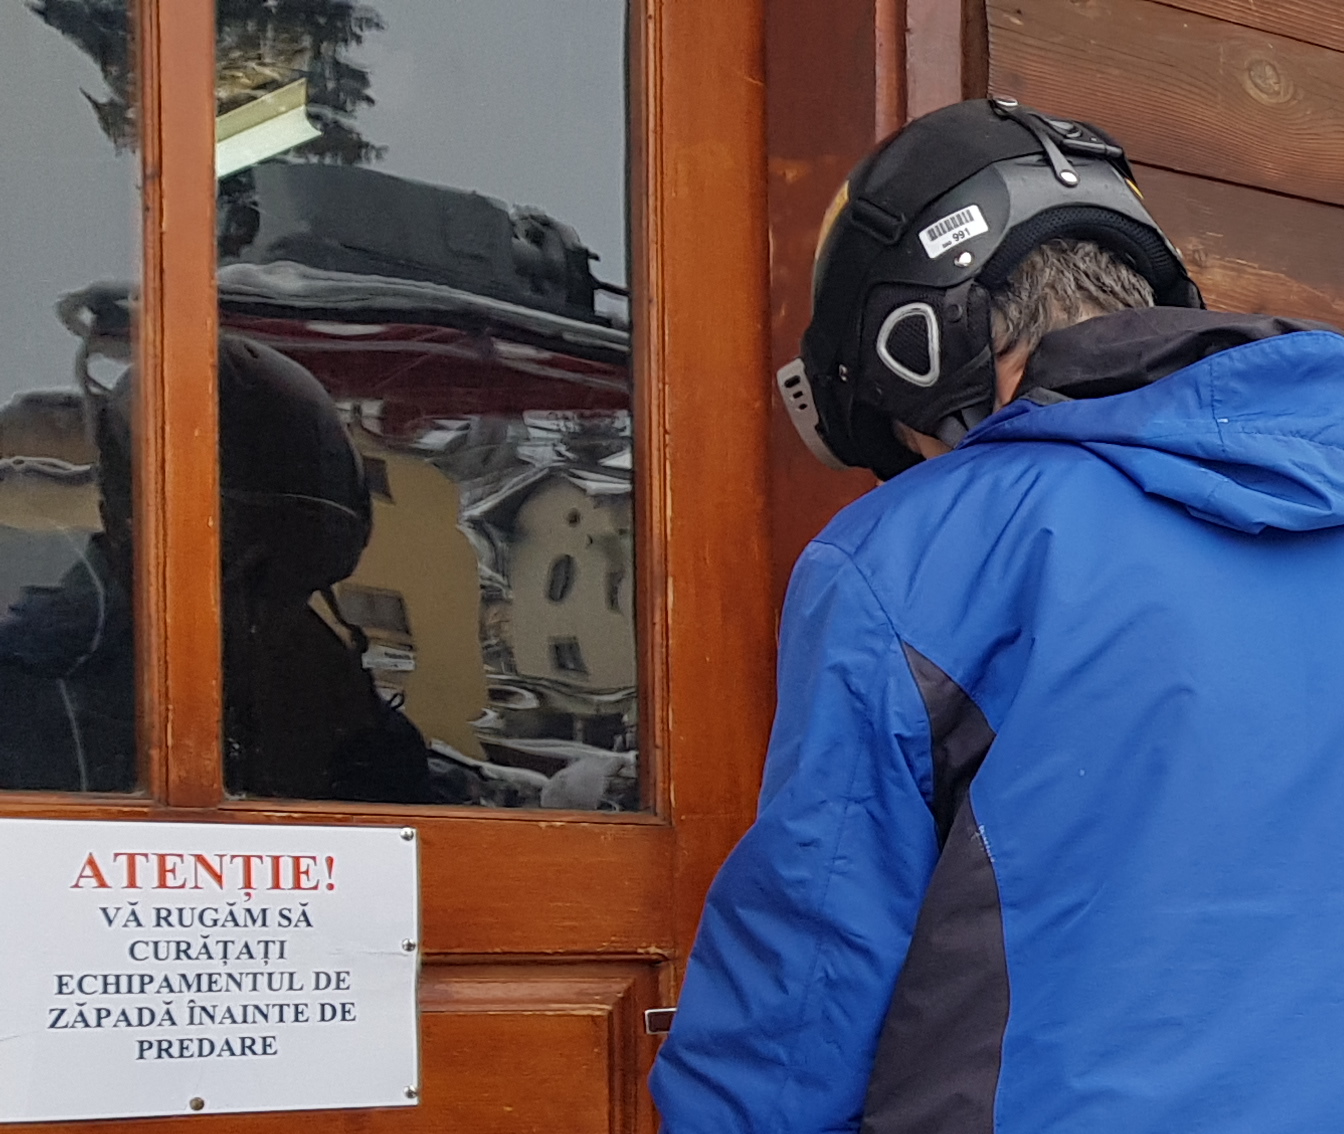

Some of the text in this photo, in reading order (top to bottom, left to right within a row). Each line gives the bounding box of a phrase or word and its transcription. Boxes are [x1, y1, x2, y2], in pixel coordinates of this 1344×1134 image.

[952, 227, 971, 242] 991
[70, 852, 336, 902] ATENȚIE!
[99, 902, 314, 928] VĂ RUGĂM SĂ
[128, 935, 288, 966] CURĂȚAȚI
[54, 971, 351, 996] ECHIPAMENTUL DE
[47, 1000, 357, 1029] ZĂPADĂ ÎNAINTE DE
[136, 1036, 279, 1060] PREDARE
